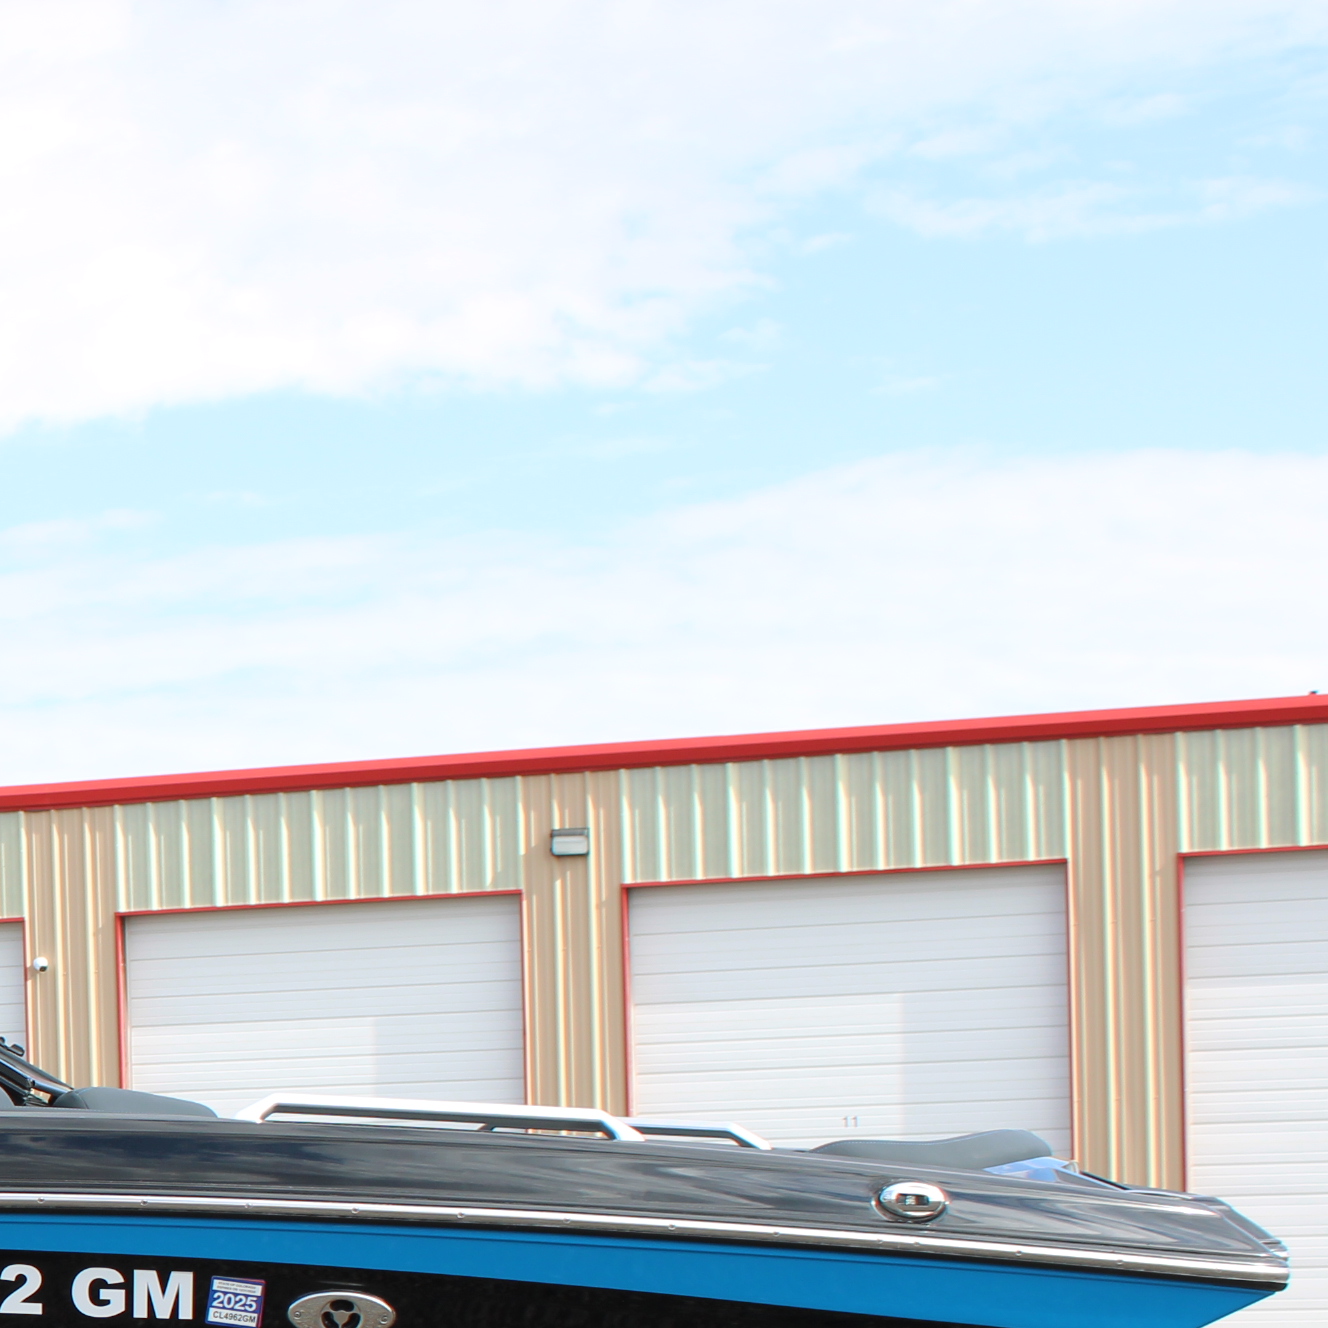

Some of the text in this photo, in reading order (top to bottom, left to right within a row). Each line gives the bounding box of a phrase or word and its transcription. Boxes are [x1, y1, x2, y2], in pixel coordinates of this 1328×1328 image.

[842, 1115, 858, 1128] 11
[71, 1267, 194, 1320] GM
[211, 1292, 258, 1312] 2025
[212, 1311, 256, 1323] CL4962GM
